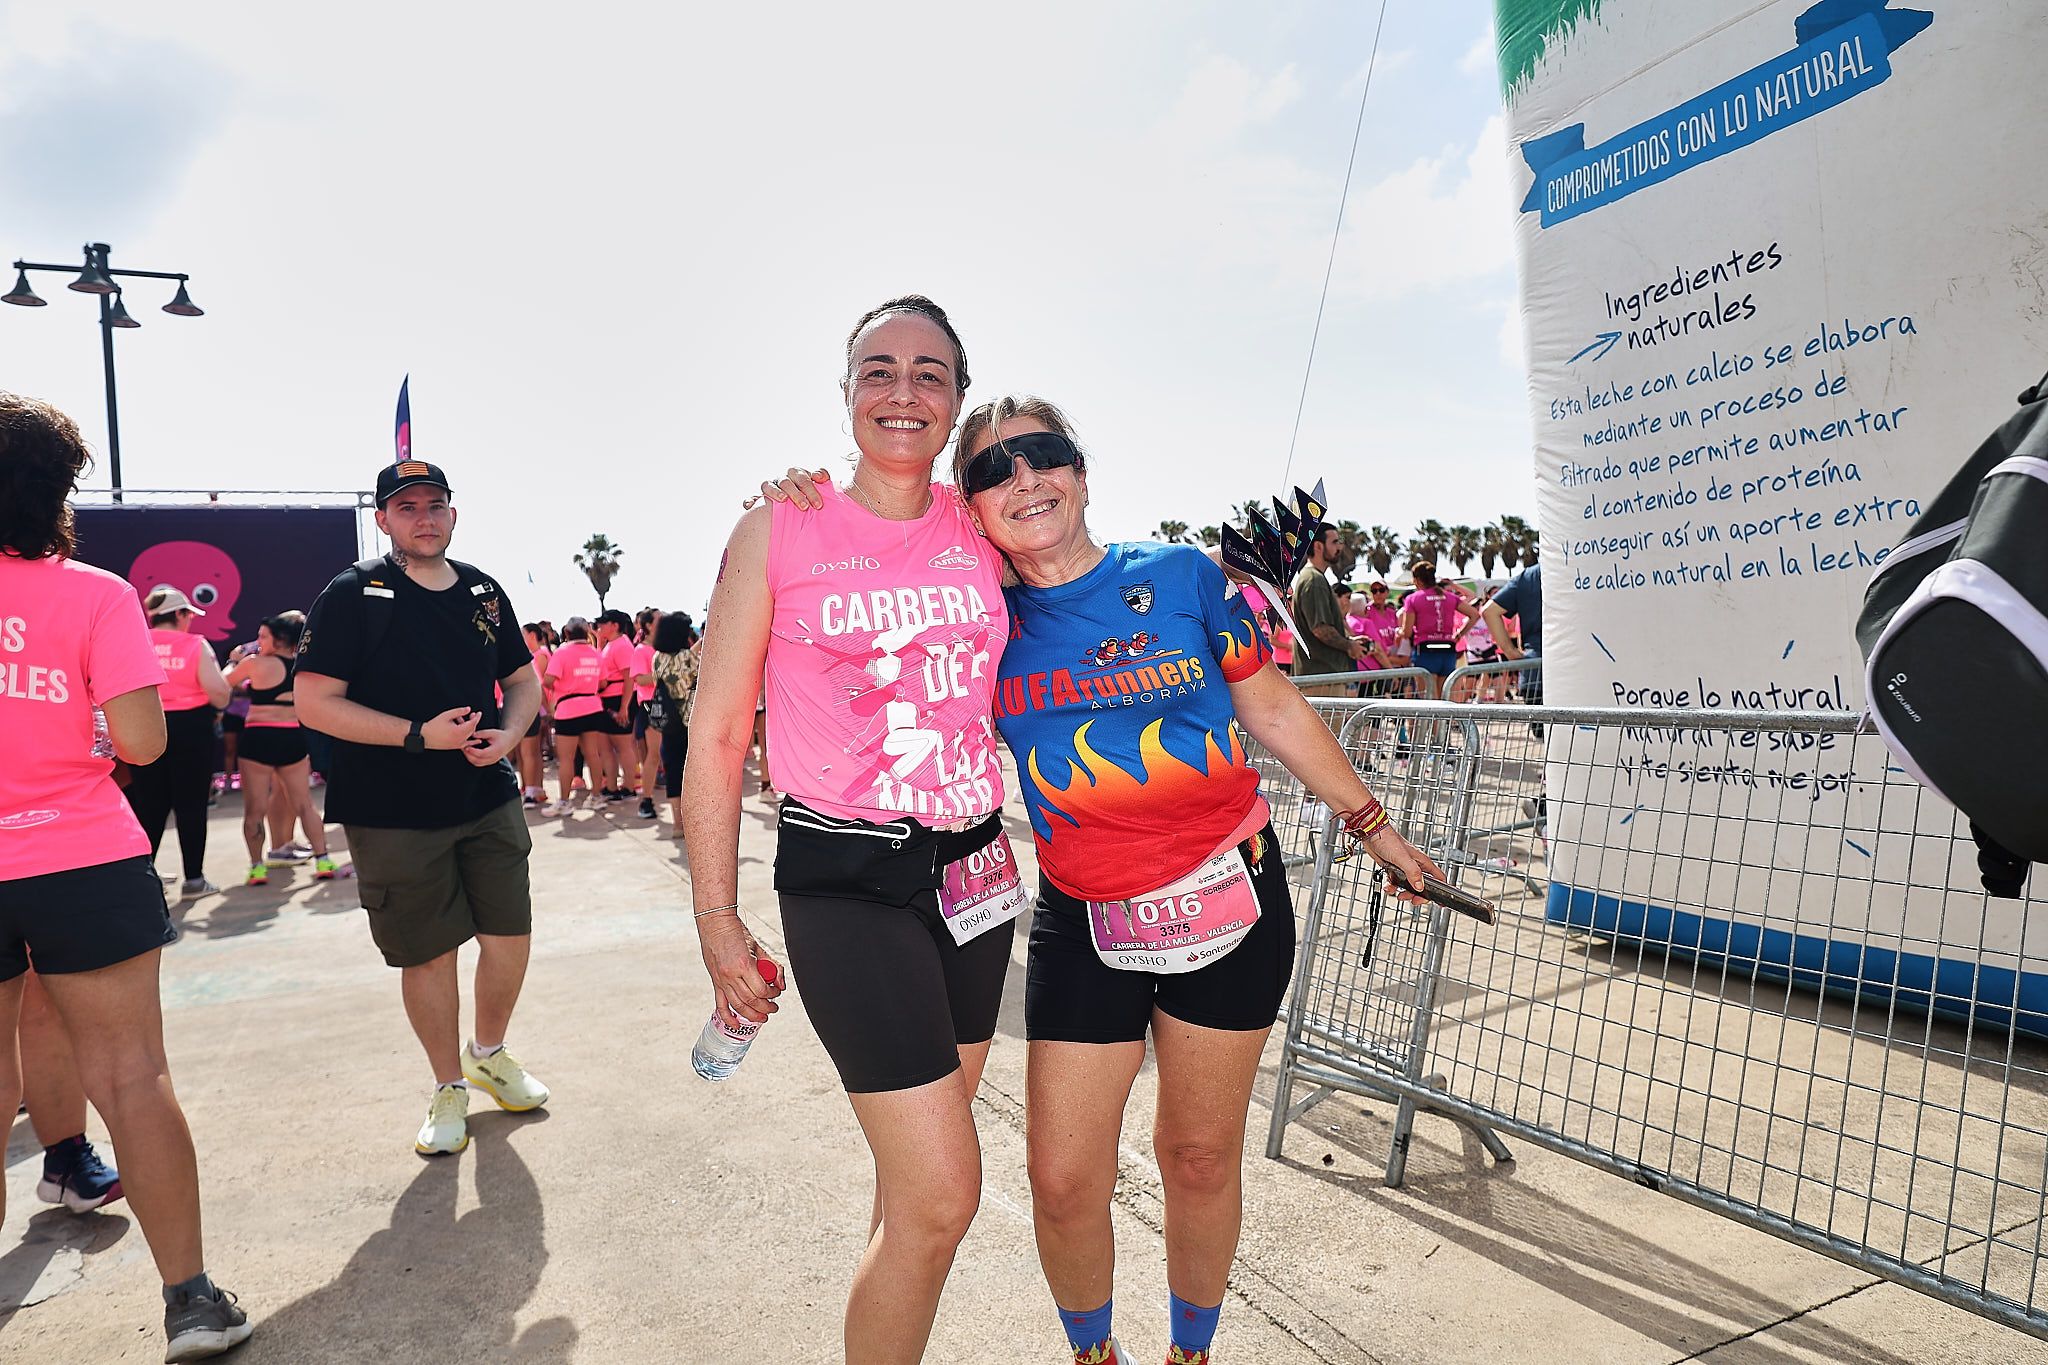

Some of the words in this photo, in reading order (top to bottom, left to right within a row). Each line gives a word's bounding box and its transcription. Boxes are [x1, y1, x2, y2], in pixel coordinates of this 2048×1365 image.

[1546, 132, 1672, 214] COMPROMETIDOS
[1675, 108, 1717, 159] CON
[1723, 94, 1749, 138] LO
[1754, 35, 1875, 123] NATURAL
[1605, 241, 1784, 324] Ingredientes
[1626, 293, 1757, 351] naturales
[1550, 399, 1583, 421] Esta
[1586, 384, 1634, 412] leche
[1640, 372, 1677, 397] con
[1686, 351, 1755, 386] calcio
[1764, 343, 1794, 369] se
[1804, 314, 1918, 357] elabora
[1583, 413, 1662, 448] mediante
[1669, 410, 1693, 429] un
[1700, 386, 1803, 429] proceso
[1814, 369, 1848, 398] de
[1560, 455, 1622, 488] filtrado
[1628, 451, 1661, 482] que
[1668, 433, 1760, 474] permite
[1769, 405, 1909, 451] aumentar
[1583, 498, 1598, 521] el
[1602, 485, 1697, 519] contenido
[1706, 474, 1733, 502] de
[1741, 458, 1862, 503] proteína
[1561, 538, 1571, 567] y
[1573, 531, 1654, 561] conseguir
[1661, 520, 1690, 548] así
[1697, 523, 1721, 543] un
[1729, 507, 1822, 546] aporte
[1833, 495, 1922, 529] extra
[811, 556, 881, 575] OYSHO
[1574, 568, 1591, 591] de
[1594, 563, 1646, 590] calcio
[1652, 552, 1733, 585] natural
[1740, 558, 1772, 580] en
[1779, 546, 1802, 576] la
[1812, 542, 1890, 571] leche
[819, 583, 991, 637] CARRERA
[922, 641, 971, 703] DE
[1091, 679, 1208, 711] ALBORAYA
[1611, 681, 1691, 709] Porque
[1697, 676, 1722, 709] lo
[1731, 675, 1850, 711] natural.
[1722, 727, 1757, 751] te
[1620, 758, 1633, 787] y
[1639, 754, 1668, 780] te
[1678, 758, 1758, 789] sienta
[1767, 768, 1865, 801] mejor.
[967, 840, 1007, 875] 016
[983, 870, 1003, 887] 3376
[959, 908, 992, 932] OYSHO
[1137, 893, 1203, 924] 016
[1111, 938, 1146, 950] CARRERA
[1147, 939, 1159, 950] DE
[1160, 938, 1171, 948] LA
[1172, 935, 1201, 947] MUJER
[1206, 919, 1244, 938] VALENCIA
[1160, 923, 1191, 938] 3375
[1199, 935, 1244, 960] Santande
[1118, 955, 1167, 967] OYSHO
